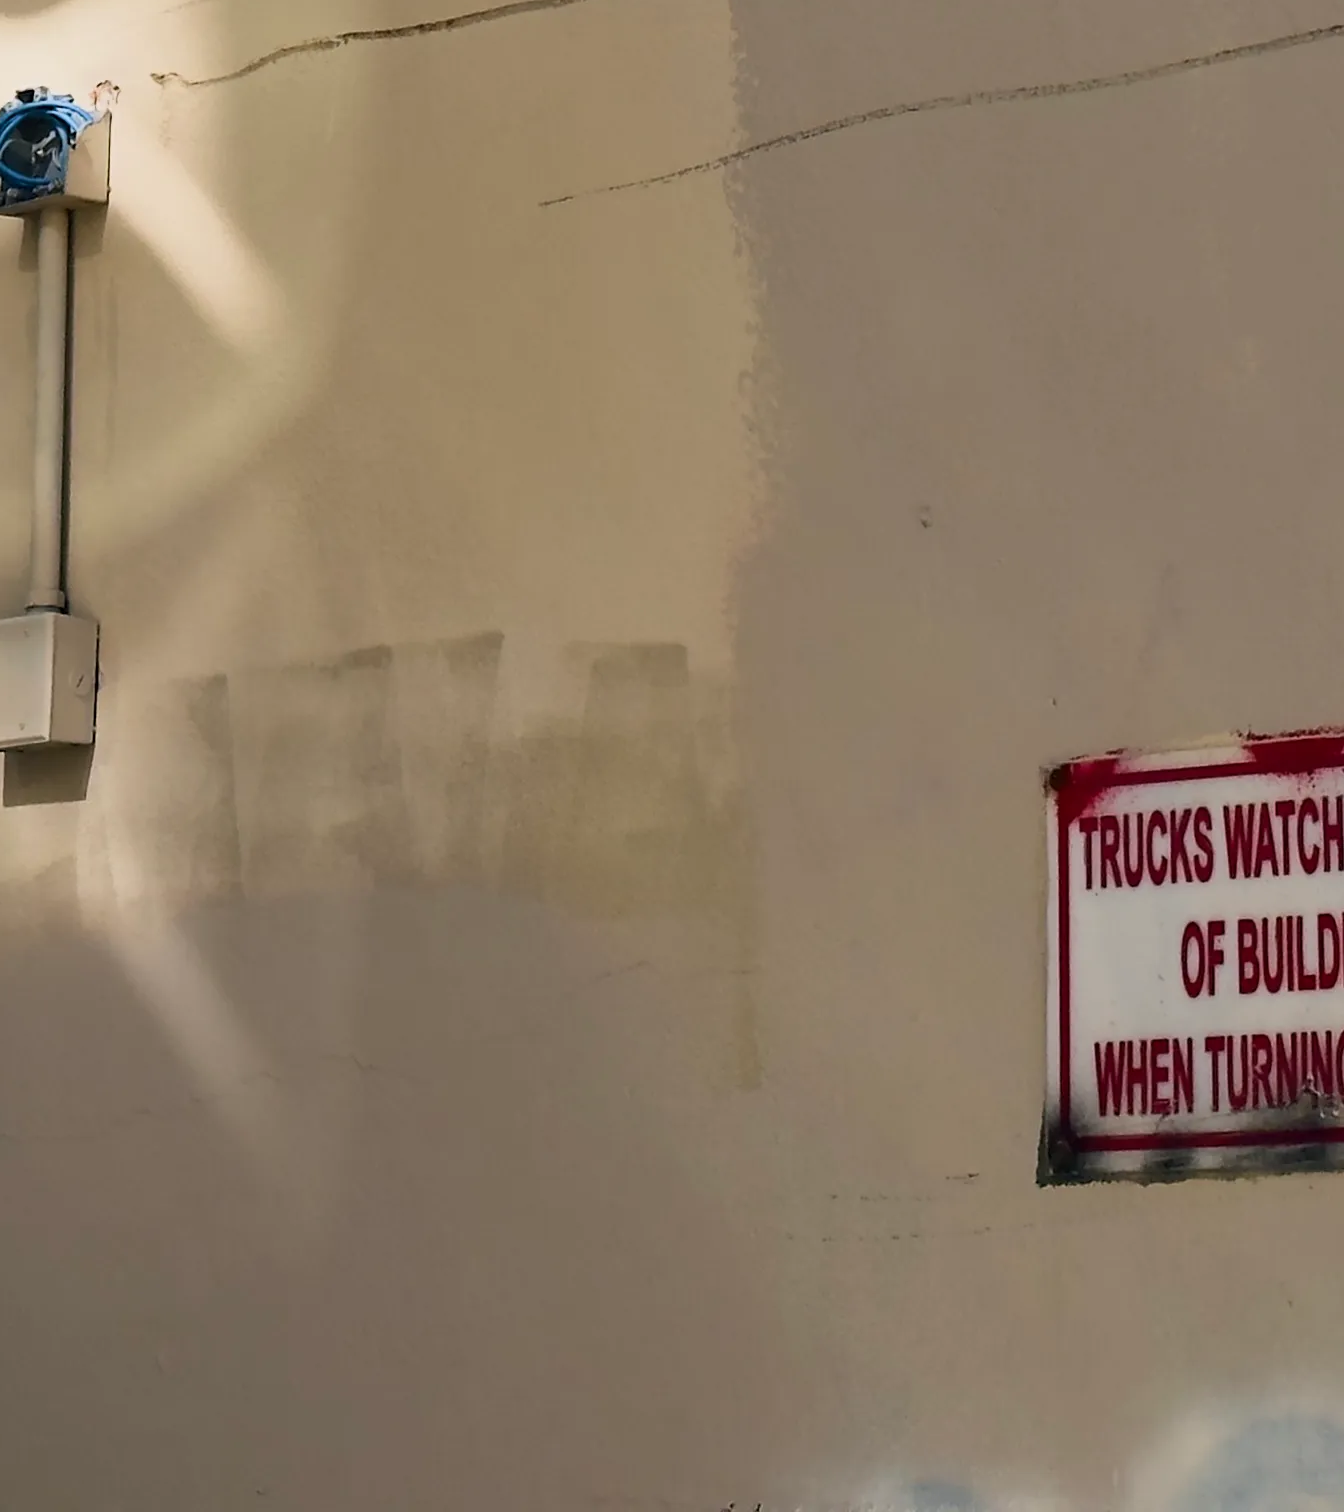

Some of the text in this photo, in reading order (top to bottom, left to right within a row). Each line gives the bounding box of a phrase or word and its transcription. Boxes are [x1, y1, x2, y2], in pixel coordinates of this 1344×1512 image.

[1079, 806, 1213, 889] TRUCKS
[1224, 794, 1344, 879] WATCH
[1181, 919, 1225, 998] OF
[1094, 1037, 1194, 1117] WHEN
